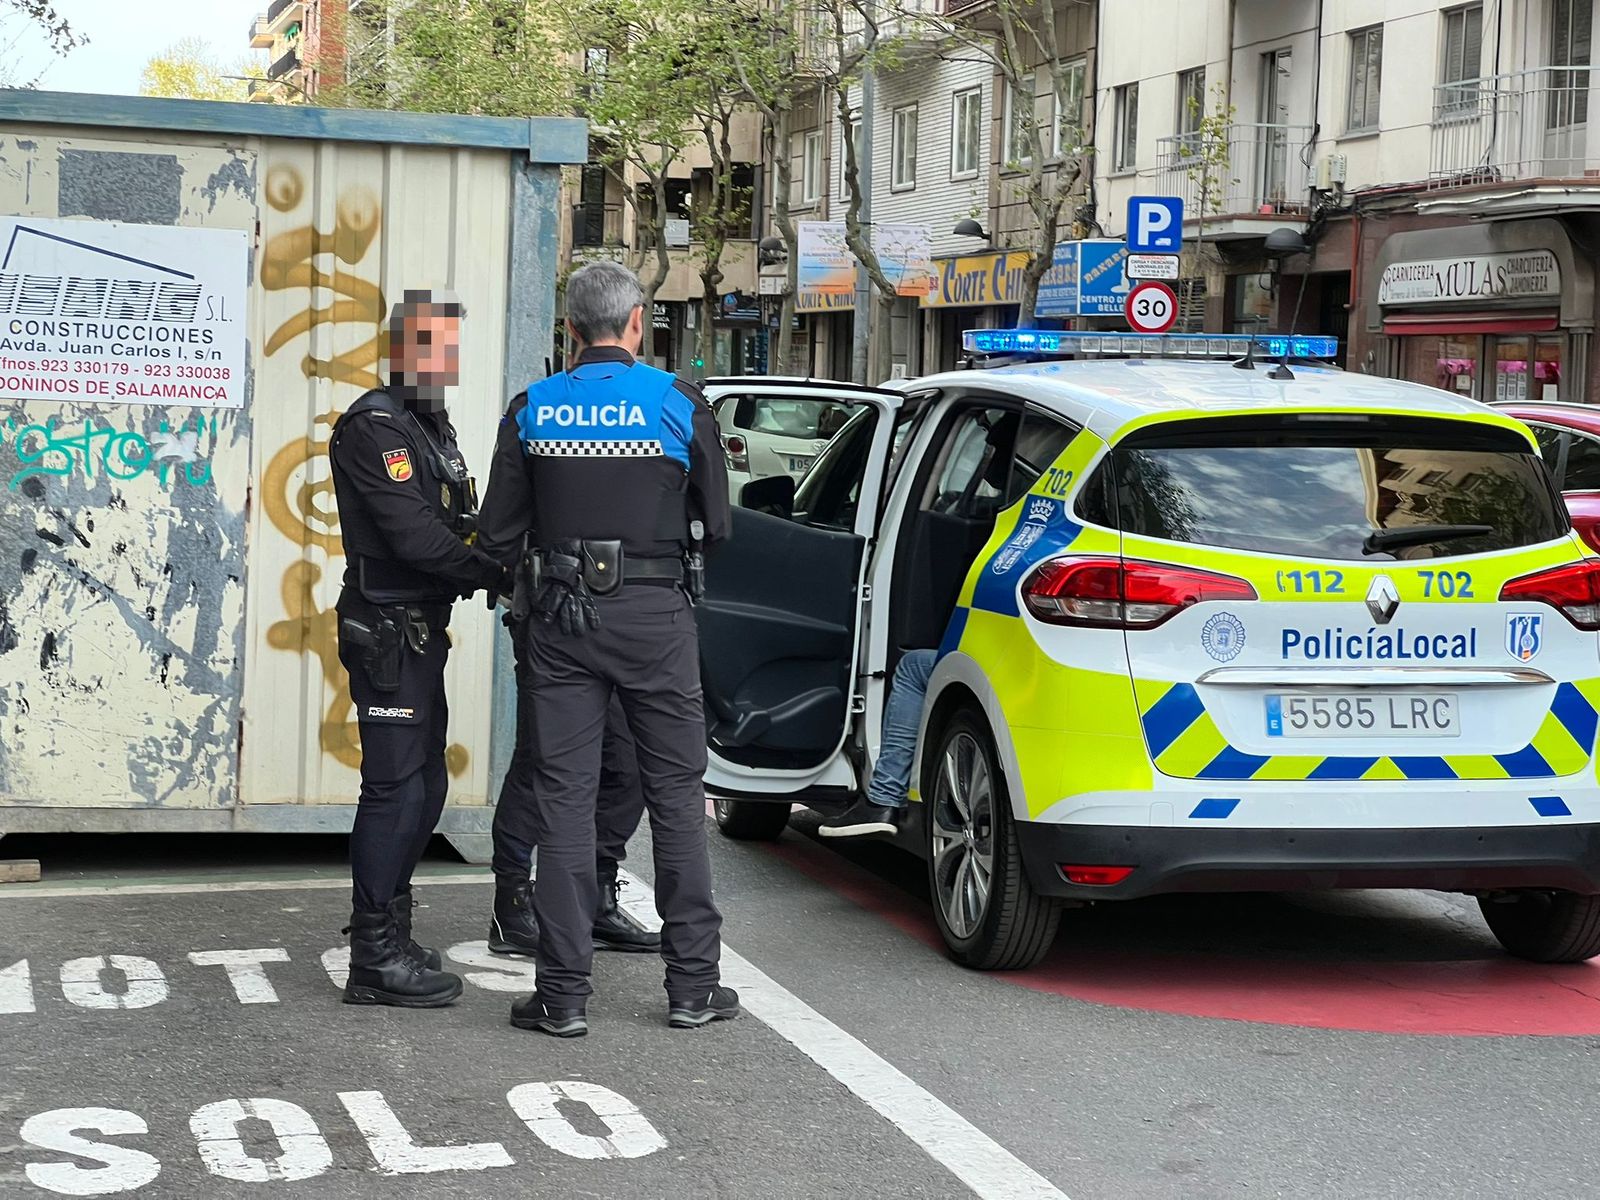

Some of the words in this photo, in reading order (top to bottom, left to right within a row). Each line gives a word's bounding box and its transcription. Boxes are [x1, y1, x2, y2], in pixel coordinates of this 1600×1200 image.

[1138, 203, 1172, 246] P
[943, 259, 987, 303] CORTE
[992, 254, 1025, 302] CHI
[1391, 264, 1435, 281] CARNICERIA
[1434, 261, 1508, 297] MULAS
[1081, 295, 1115, 303] CENTRO
[1098, 303, 1125, 312] BELLE
[1137, 299, 1166, 317] 30
[9, 319, 214, 344] CONSTRUCCIONES
[0, 338, 52, 353] Avda.
[59, 341, 104, 355] Juan
[111, 343, 171, 358] Carlos
[194, 347, 222, 361] s/n
[74, 360, 129, 376] 330179
[144, 364, 171, 378] 923
[176, 365, 231, 380] 330038
[86, 380, 110, 395] DE
[116, 382, 228, 400] SALAMANCA
[536, 400, 647, 426] POLICÍA
[1043, 468, 1073, 496] 702
[1288, 570, 1344, 593] 112
[1418, 570, 1474, 598] 702
[1289, 698, 1376, 729] 5585
[1389, 698, 1451, 729] LRC
[20, 1080, 669, 1196] SOLO
